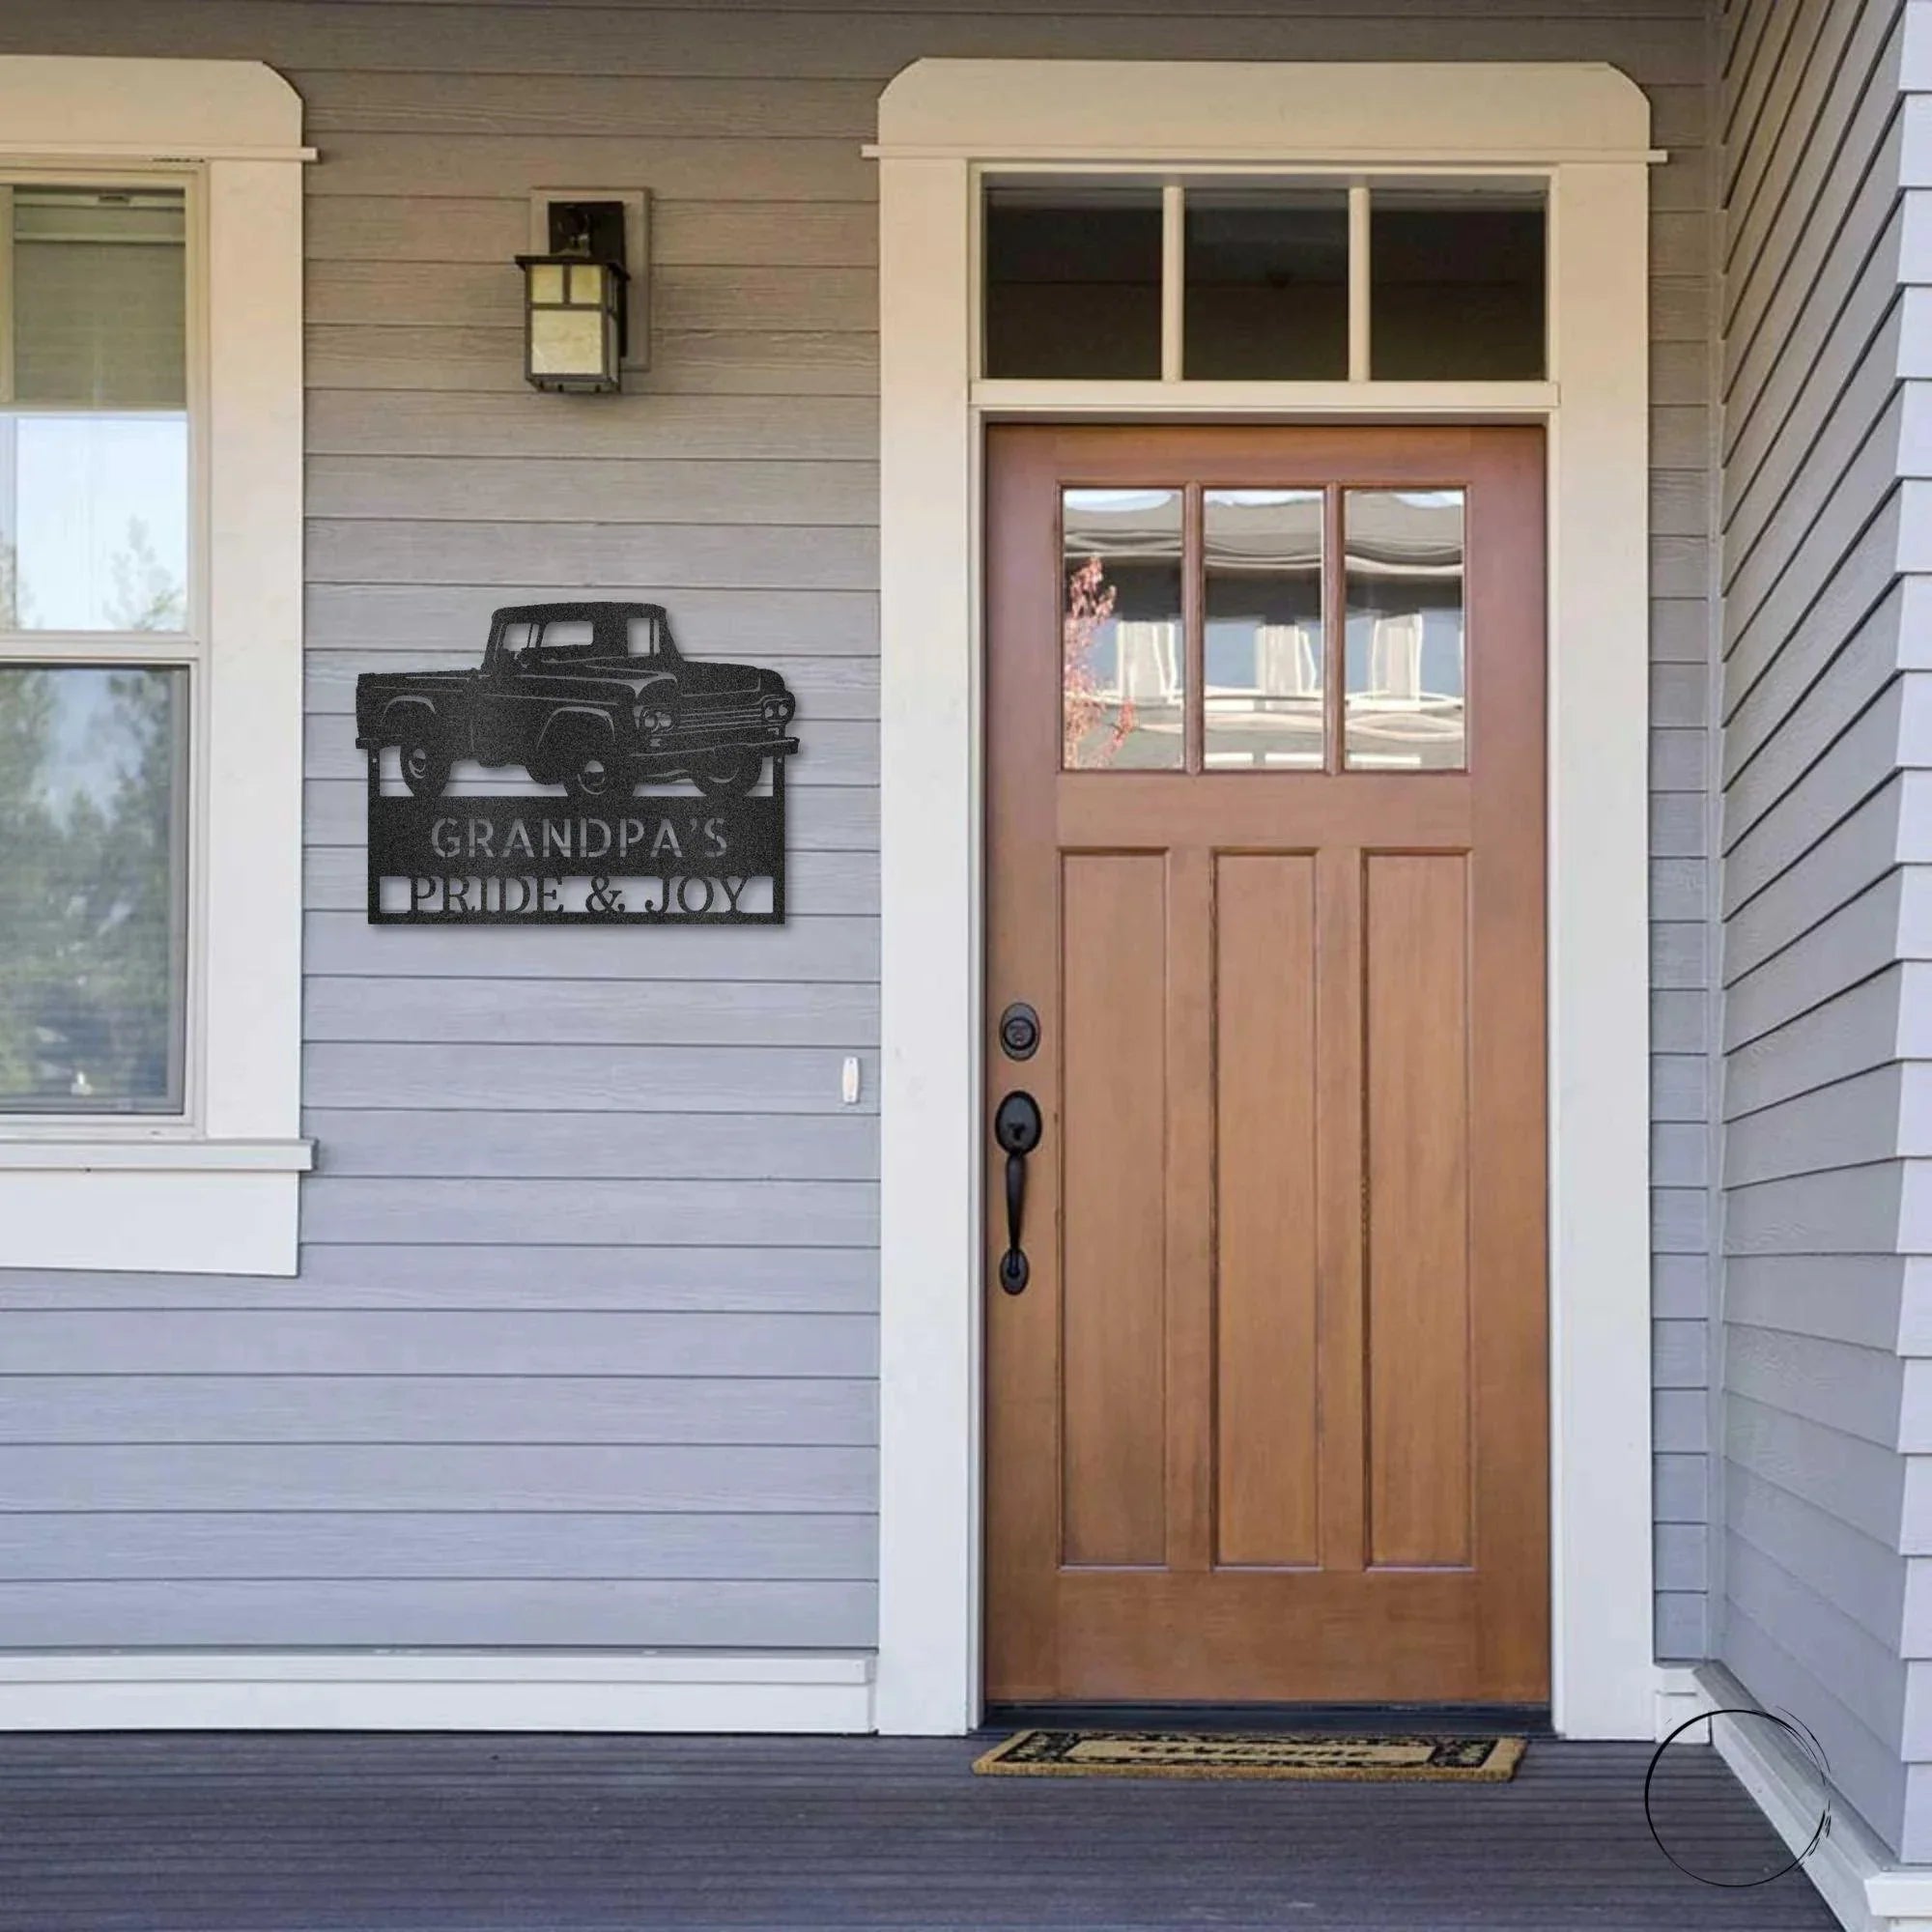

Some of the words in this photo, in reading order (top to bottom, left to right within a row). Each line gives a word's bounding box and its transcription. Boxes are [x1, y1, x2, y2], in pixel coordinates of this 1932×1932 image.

[431, 817, 728, 859] GRANDPA'S
[409, 875, 564, 914] PRIDE
[584, 875, 627, 914] &
[644, 875, 751, 914] JOY
